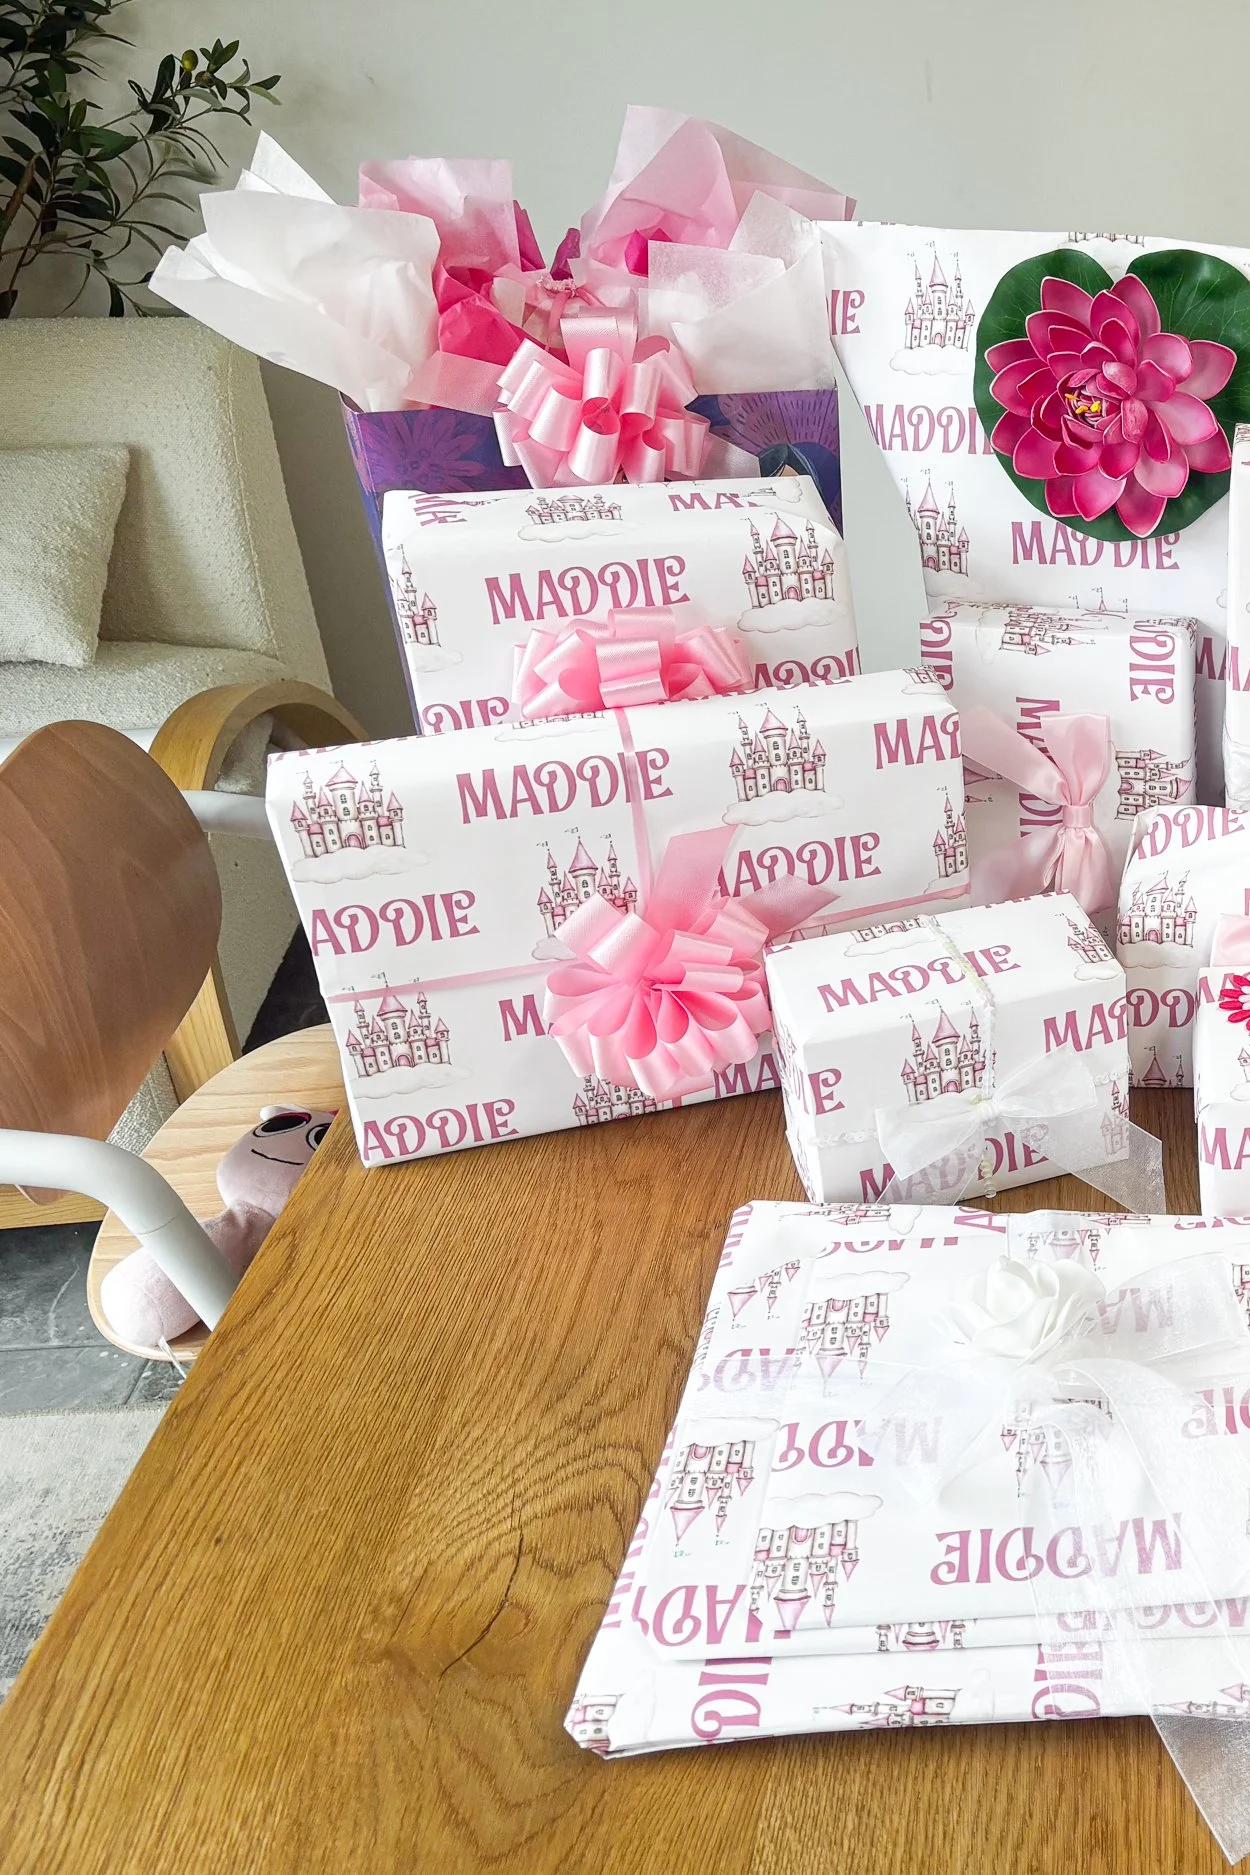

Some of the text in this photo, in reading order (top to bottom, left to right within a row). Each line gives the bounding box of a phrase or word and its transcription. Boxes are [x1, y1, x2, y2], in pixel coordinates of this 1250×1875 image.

[864, 404, 995, 455] MADDI
[485, 555, 691, 625] MADDIE
[456, 748, 674, 824] MADDIE
[717, 832, 882, 898] ADDIE
[312, 890, 480, 957] ADDIE
[363, 1099, 519, 1161] ADDIE
